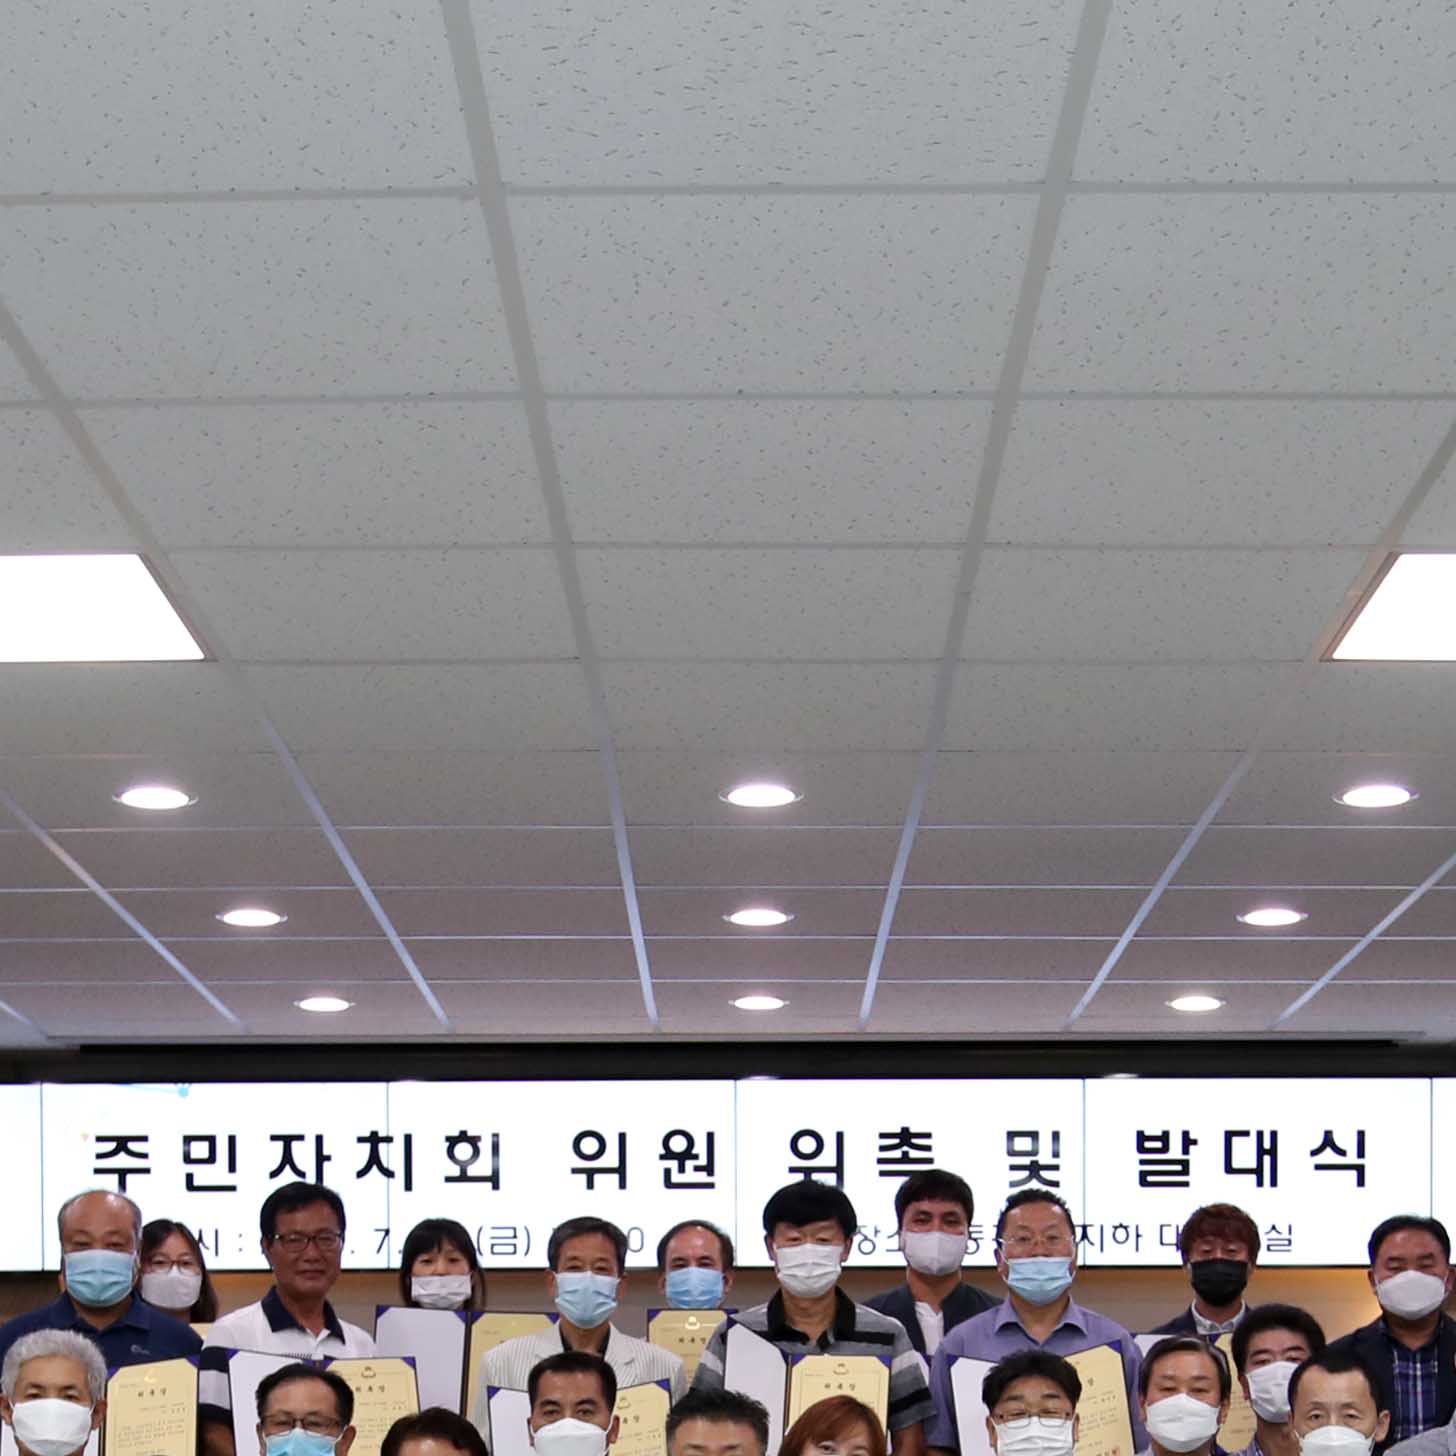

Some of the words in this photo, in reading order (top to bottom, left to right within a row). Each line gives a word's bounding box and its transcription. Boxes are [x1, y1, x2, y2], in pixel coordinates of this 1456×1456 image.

[93, 1130, 500, 1192] 주민자치회
[571, 1129, 716, 1190] 위원
[788, 1126, 934, 1189] 위촉
[1006, 1130, 1060, 1188] 및
[1136, 1130, 1365, 1188] 발대식
[1074, 1223, 1143, 1253] 지하
